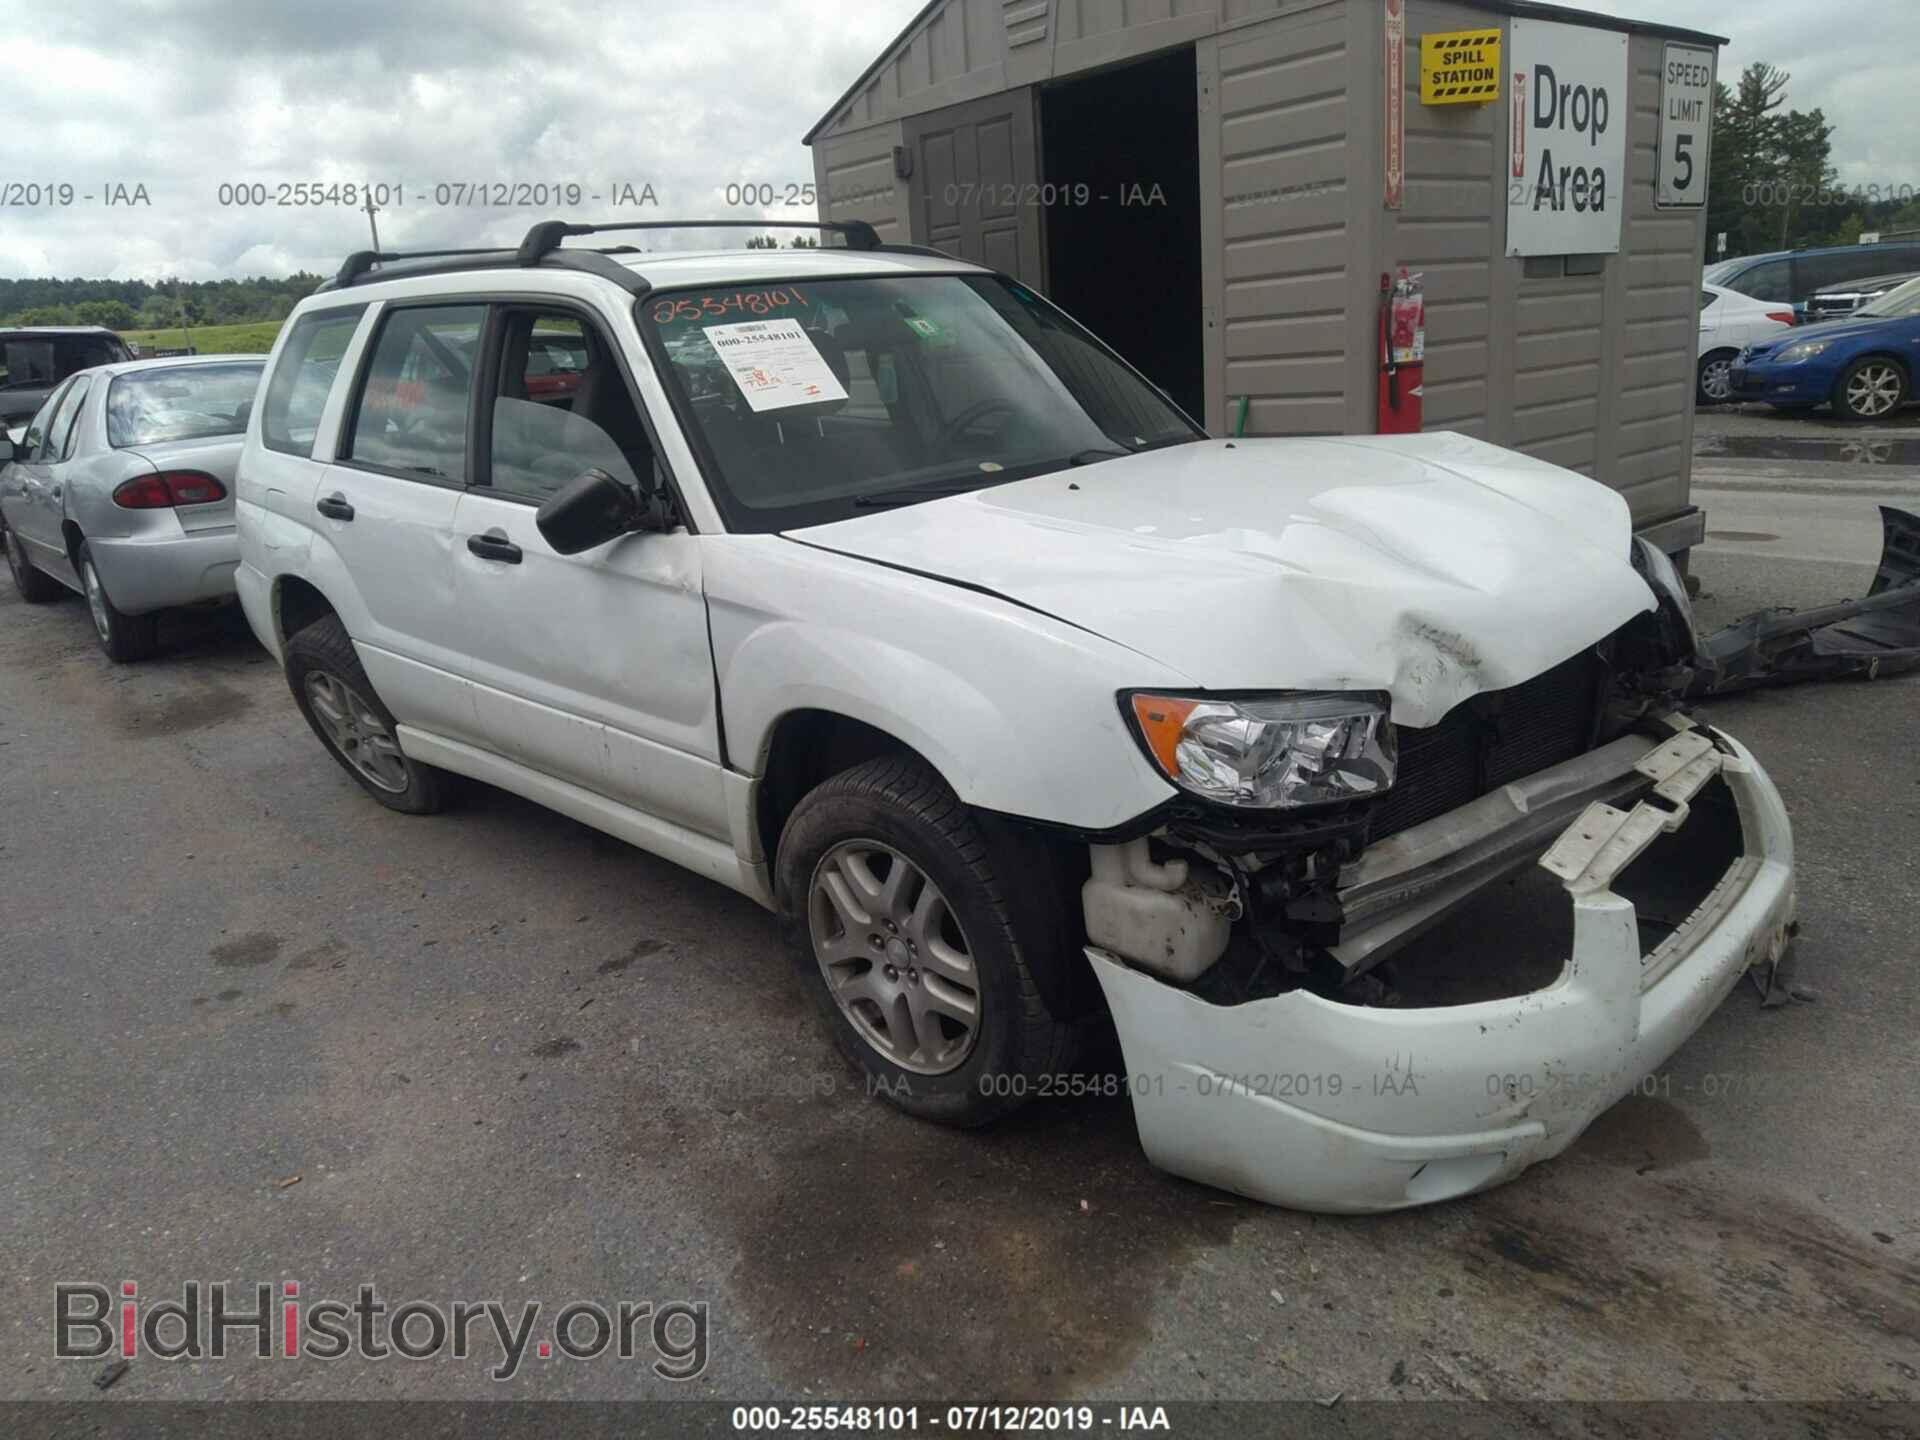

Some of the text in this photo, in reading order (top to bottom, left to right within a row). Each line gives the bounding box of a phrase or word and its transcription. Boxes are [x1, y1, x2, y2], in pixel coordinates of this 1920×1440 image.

[1442, 50, 1485, 65] SPILL
[1432, 68, 1494, 84] STATION
[1667, 62, 1709, 88] SPEED
[1533, 63, 1609, 146] Drop
[1669, 100, 1703, 123] LIMIT
[1672, 134, 1694, 190] 5
[1532, 149, 1607, 213] Area
[717, 331, 801, 347] 000-25548101
